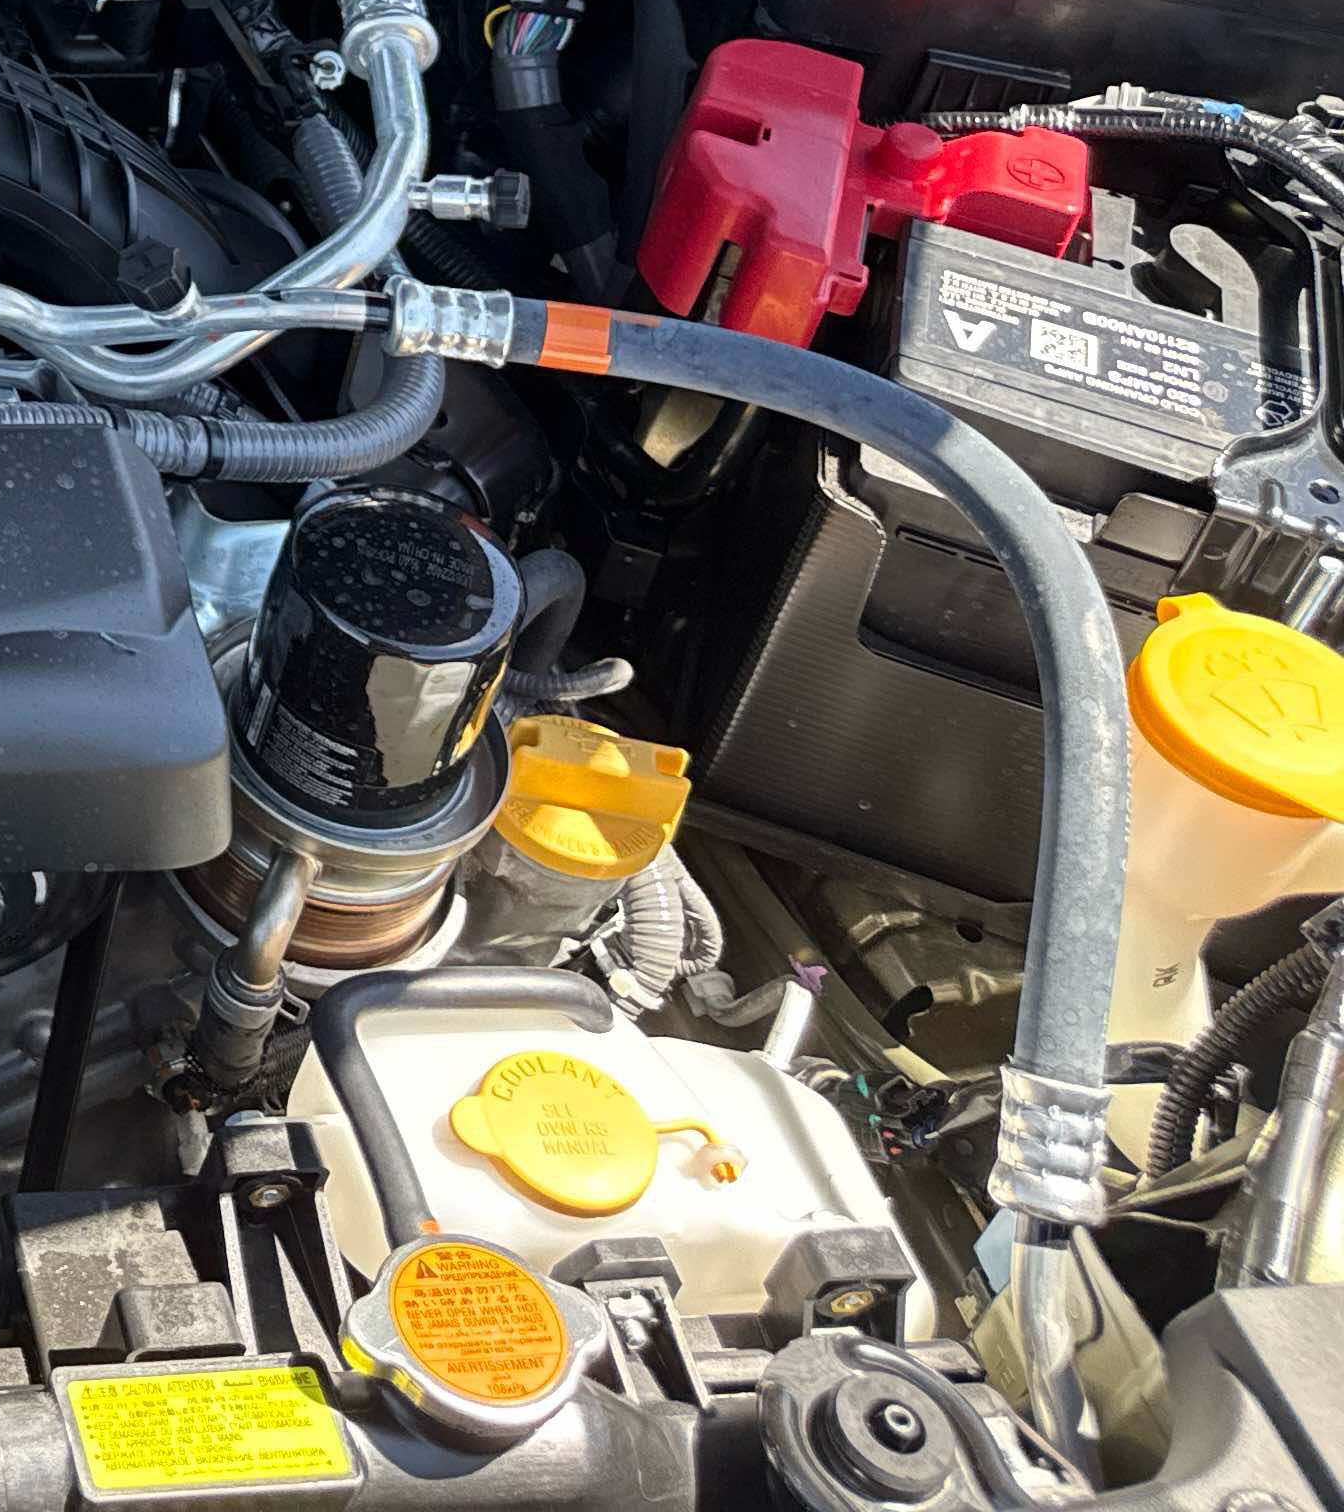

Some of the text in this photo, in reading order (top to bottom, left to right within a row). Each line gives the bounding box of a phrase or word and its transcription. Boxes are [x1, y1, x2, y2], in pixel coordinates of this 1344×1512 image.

[1162, 360, 1200, 382] LN2
[1044, 363, 1201, 418] COLD CRANKING AMPS
[1107, 370, 1164, 395] AMPS
[1149, 371, 1201, 392] GROUP
[491, 1056, 625, 1102] COOLANT
[542, 1139, 617, 1157] MANUAL
[436, 1259, 500, 1272] WARNING
[407, 1307, 442, 1320] NEVER
[447, 1306, 476, 1319] OPEN
[480, 1304, 513, 1316] WHEN
[412, 1319, 423, 1330] NE
[428, 1317, 461, 1330] JAMAIS
[463, 1315, 499, 1328] OUVRIR
[447, 1356, 545, 1374] AVERTISSEMENT
[122, 1379, 216, 1397] CAUTION ATTENTION
